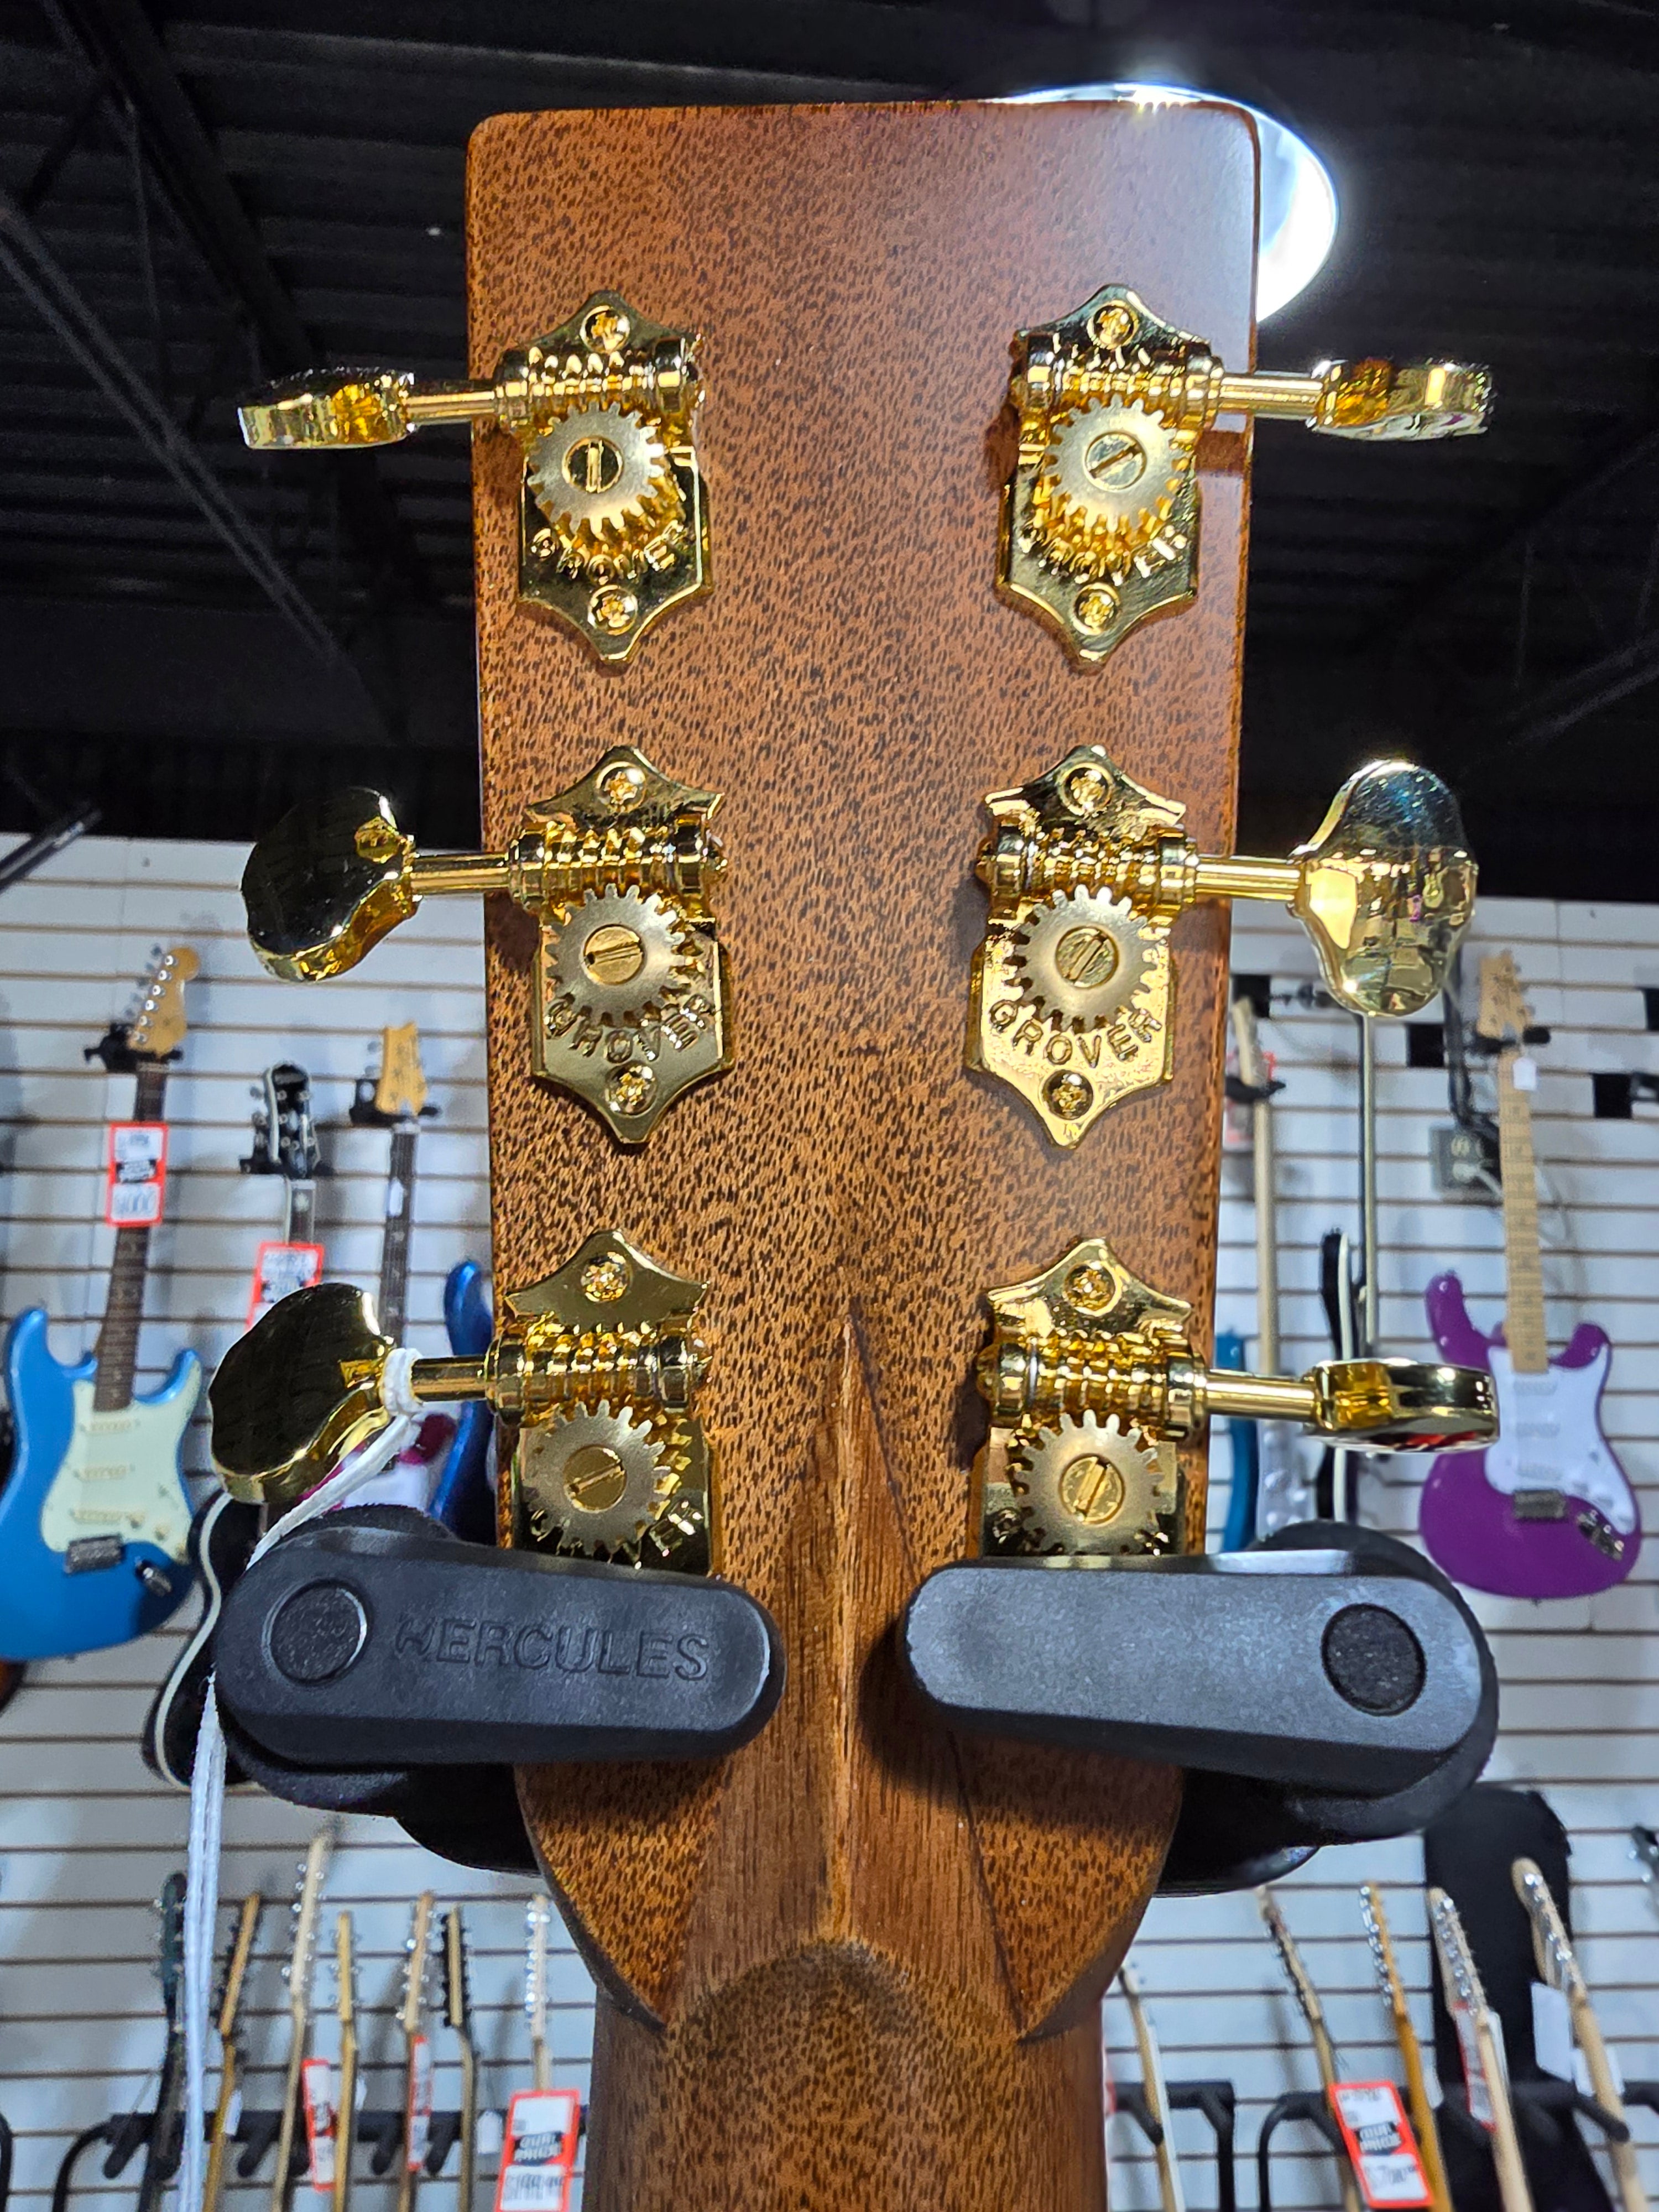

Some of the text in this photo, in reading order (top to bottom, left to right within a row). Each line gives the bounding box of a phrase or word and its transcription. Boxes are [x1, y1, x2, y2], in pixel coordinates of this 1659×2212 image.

[544, 993, 712, 1064] GROVER
[989, 999, 1162, 1068] GROVER
[394, 1615, 711, 1682] HERCULES
